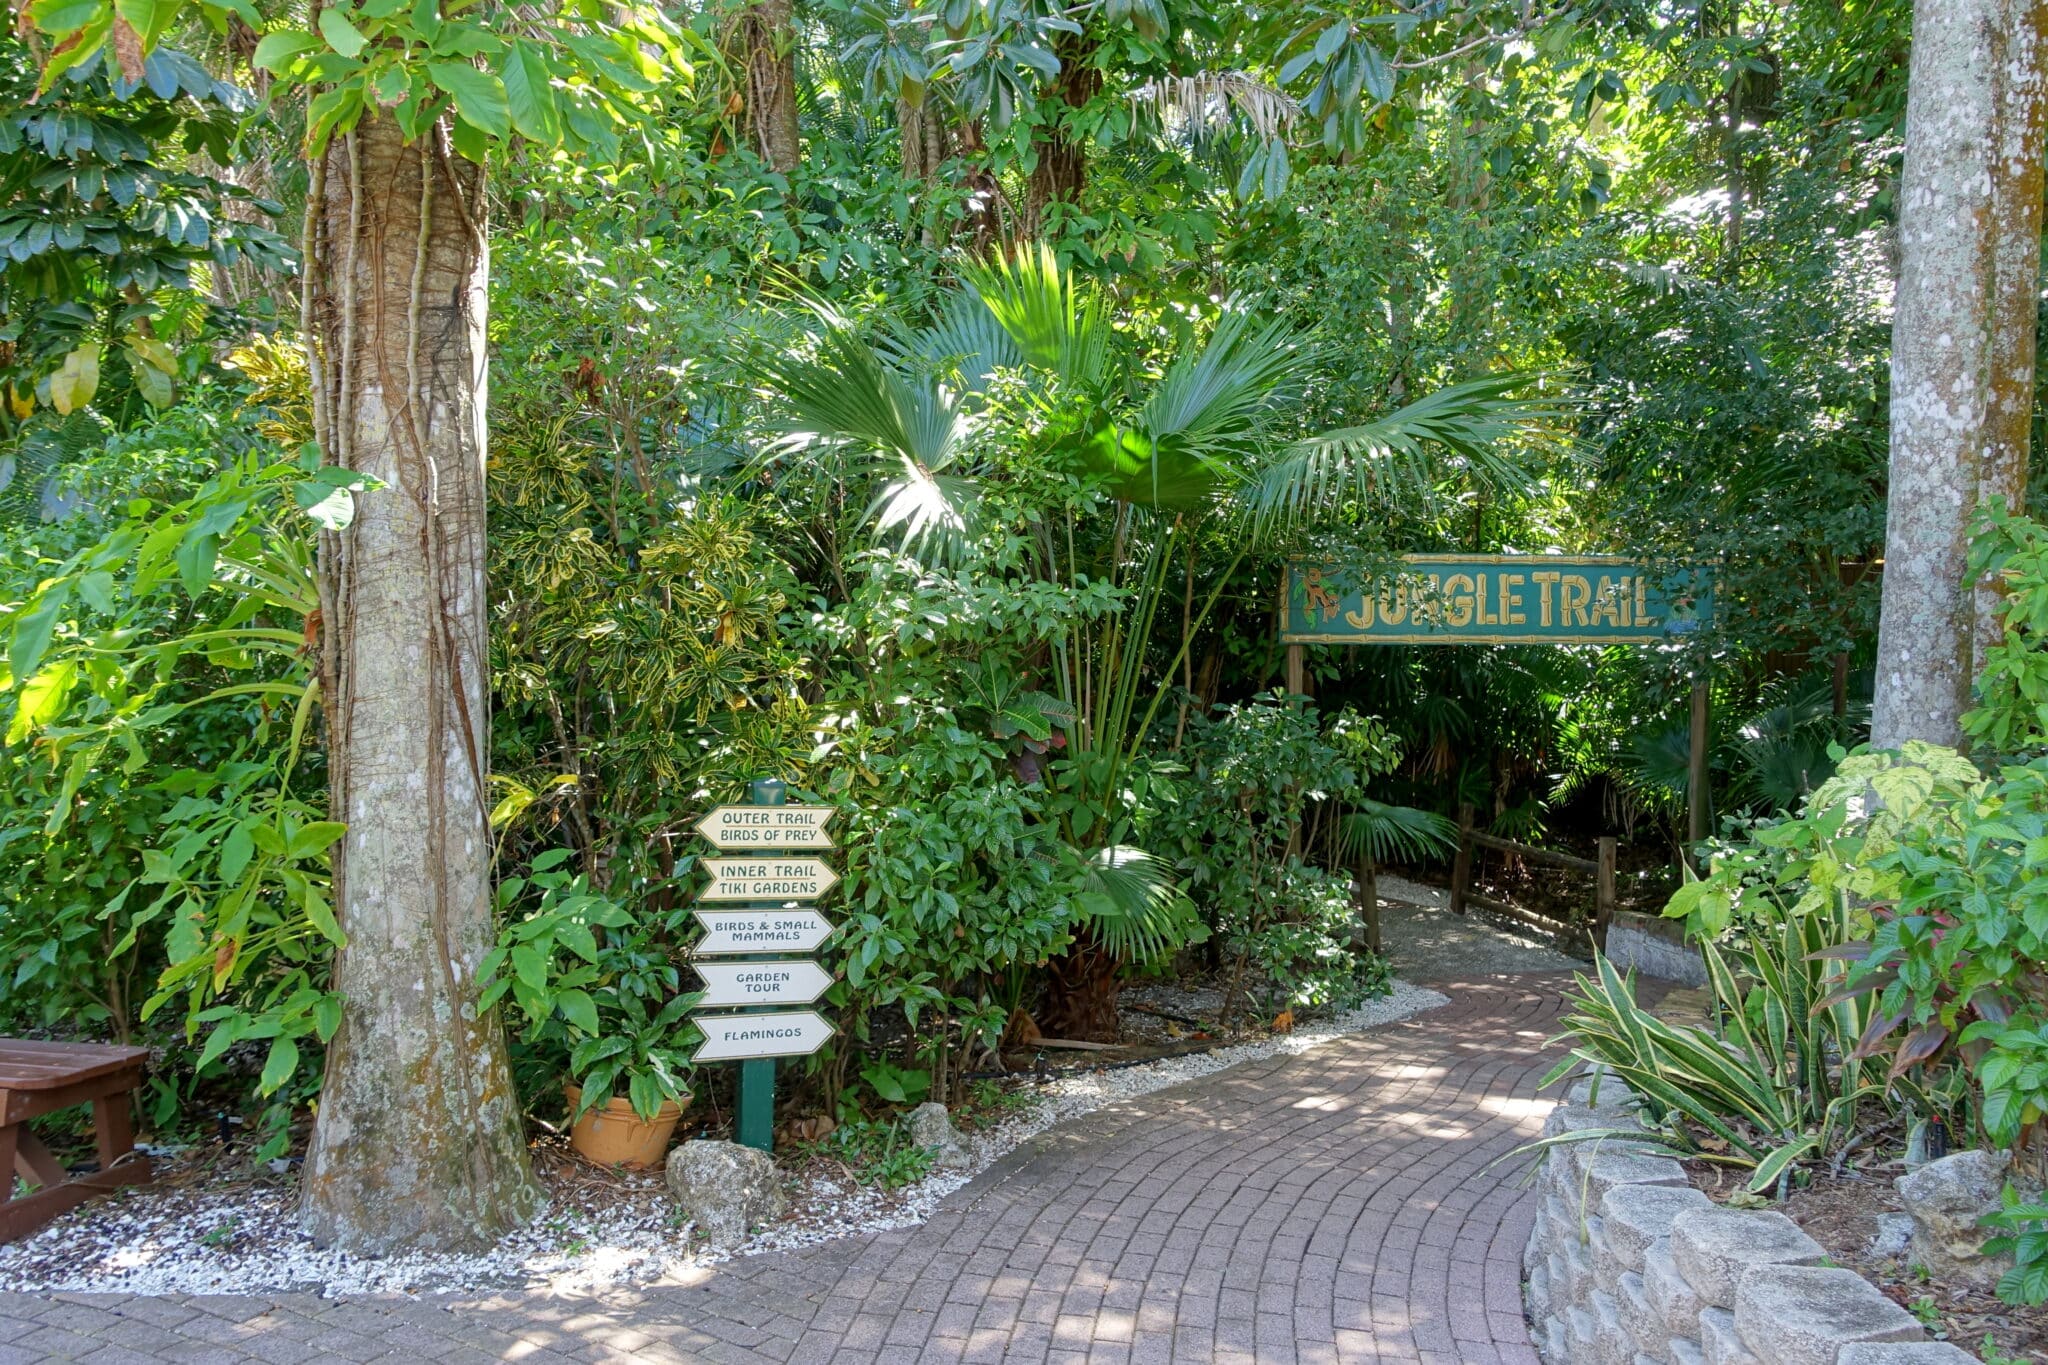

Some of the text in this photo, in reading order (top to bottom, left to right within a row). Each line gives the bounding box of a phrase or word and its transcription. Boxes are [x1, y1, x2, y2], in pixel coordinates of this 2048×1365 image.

[1532, 571, 1659, 628] TRAIL
[722, 812, 816, 825] OUTER TRAIL
[720, 829, 817, 841] BIRDS OF PREY
[721, 865, 817, 877] INNER TRAIL
[719, 882, 817, 894] TIKI GARDENS
[715, 920, 817, 932] BIRDS & SMALL
[732, 931, 801, 942] MAMMALS
[736, 972, 790, 983] GARDEN
[744, 983, 781, 993] TOUR
[724, 1027, 802, 1041] FLAMINGOS
